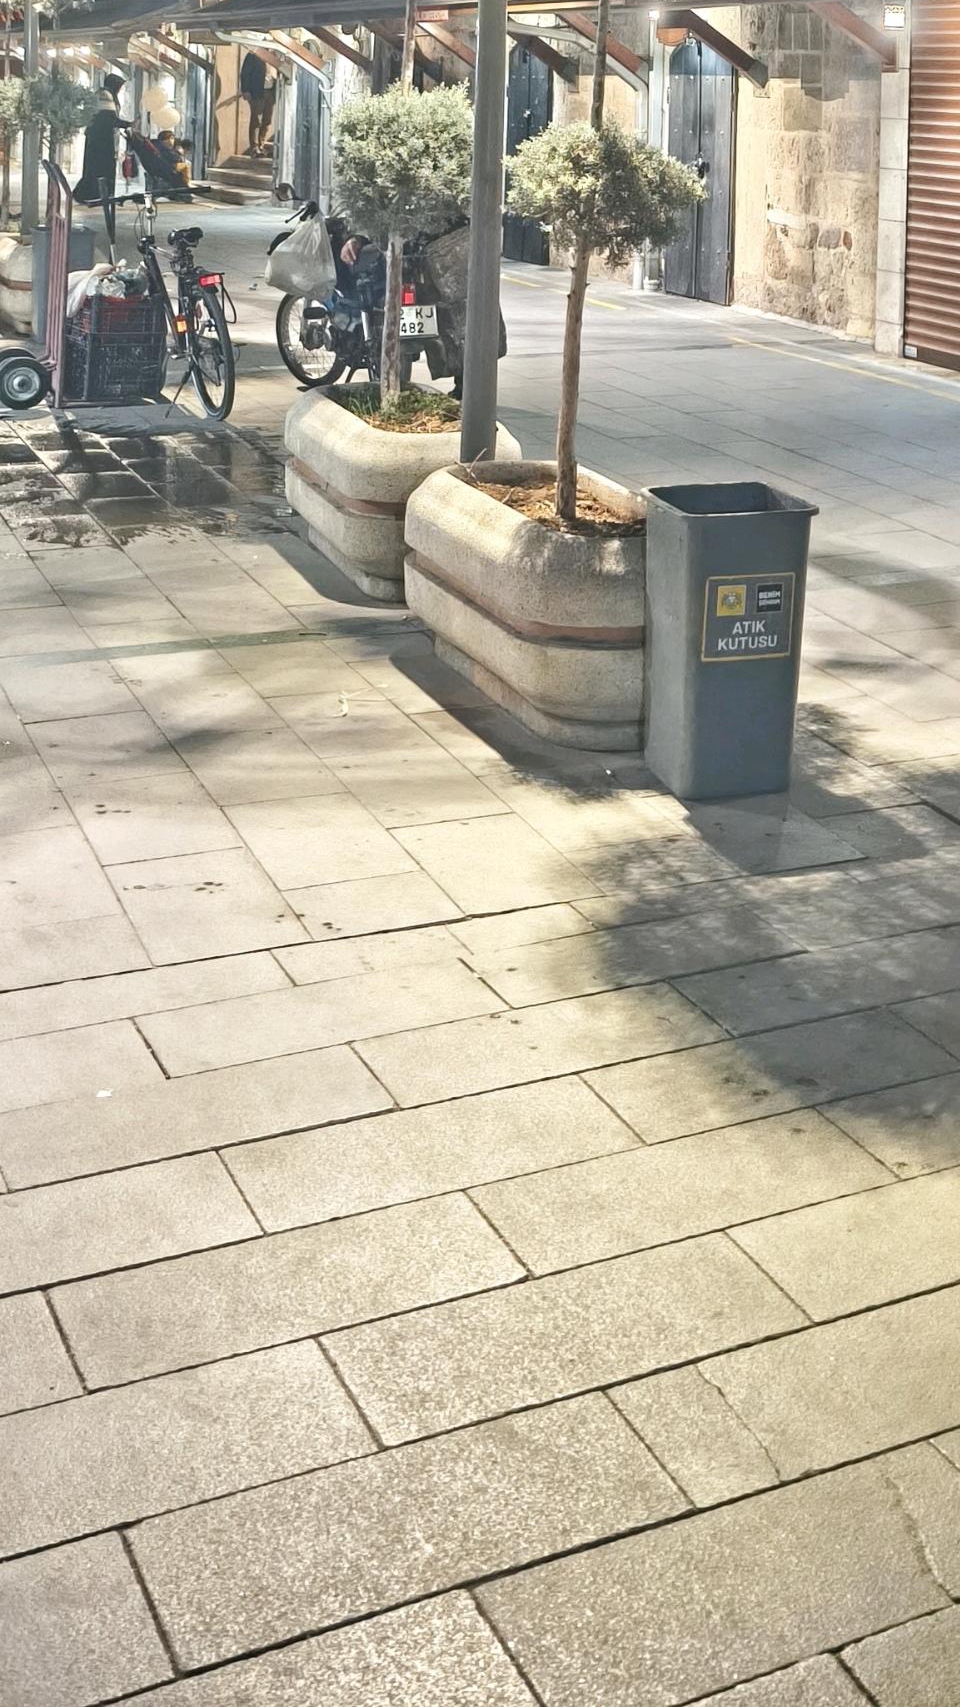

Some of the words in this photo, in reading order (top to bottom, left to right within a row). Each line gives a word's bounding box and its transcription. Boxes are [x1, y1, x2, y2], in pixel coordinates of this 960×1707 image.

[415, 307, 434, 319] KJ
[401, 322, 424, 334] 482
[732, 620, 766, 635] ATIK
[717, 635, 777, 651] KUTUSU
